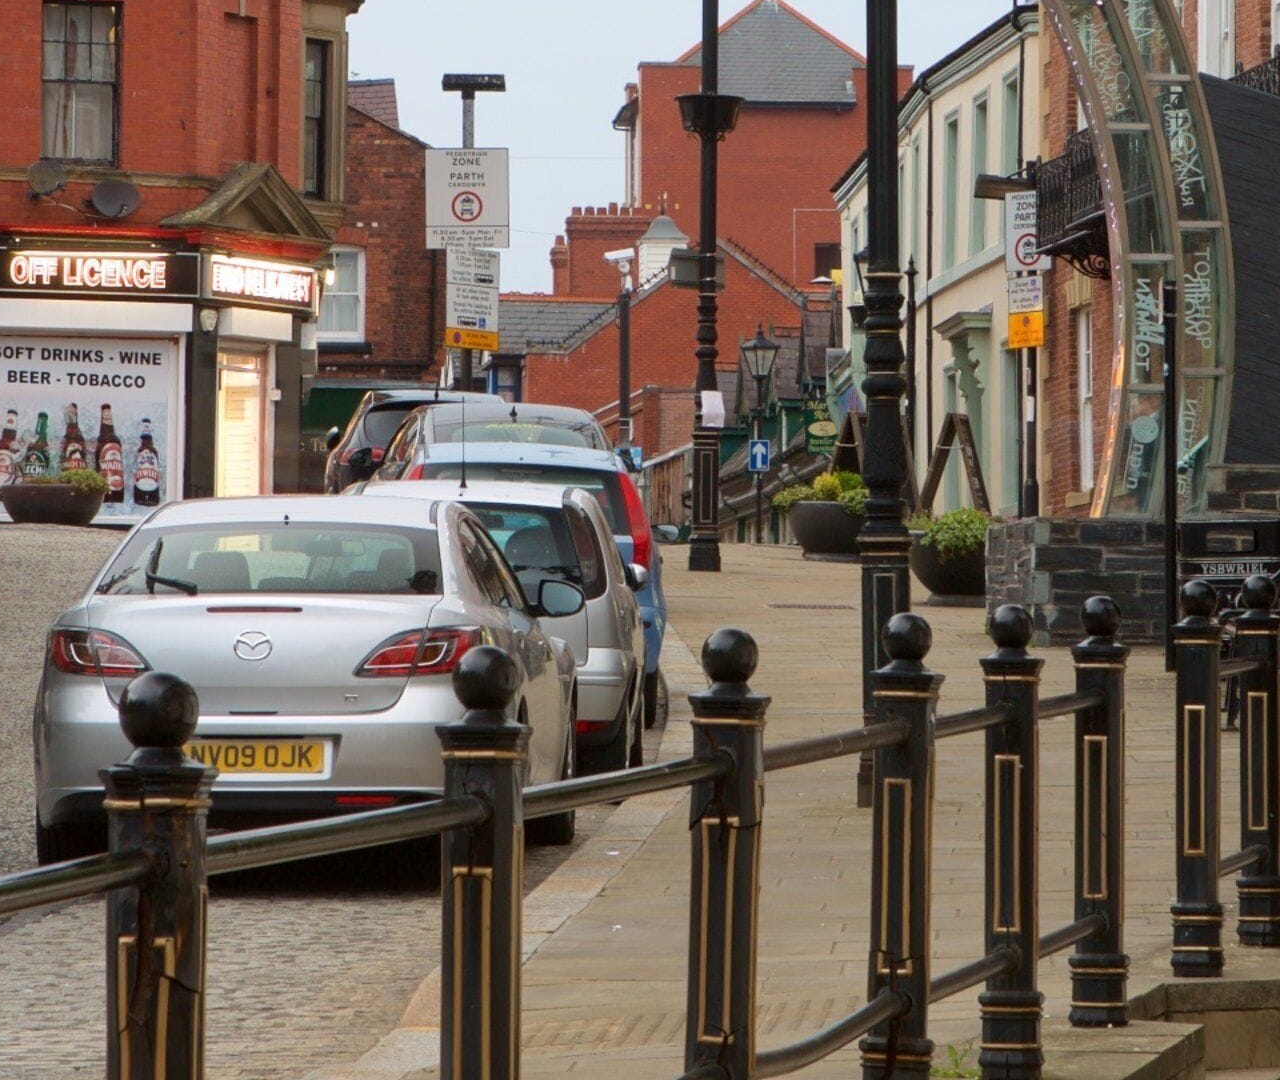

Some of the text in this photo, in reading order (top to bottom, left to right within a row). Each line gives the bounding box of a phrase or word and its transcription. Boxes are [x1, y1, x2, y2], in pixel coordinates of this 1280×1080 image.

[452, 158, 481, 166] ZONE
[450, 172, 485, 180] PARTH
[1014, 212, 1037, 221] PART
[10, 256, 166, 289] OFF LICENCE
[40, 347, 104, 363] DRINKS
[119, 351, 162, 366] WINE
[7, 370, 51, 384] BEER
[66, 372, 146, 388] TOBACCO
[1200, 563, 1268, 574] YSBWRIEL
[191, 745, 313, 768] NV09 OJK
